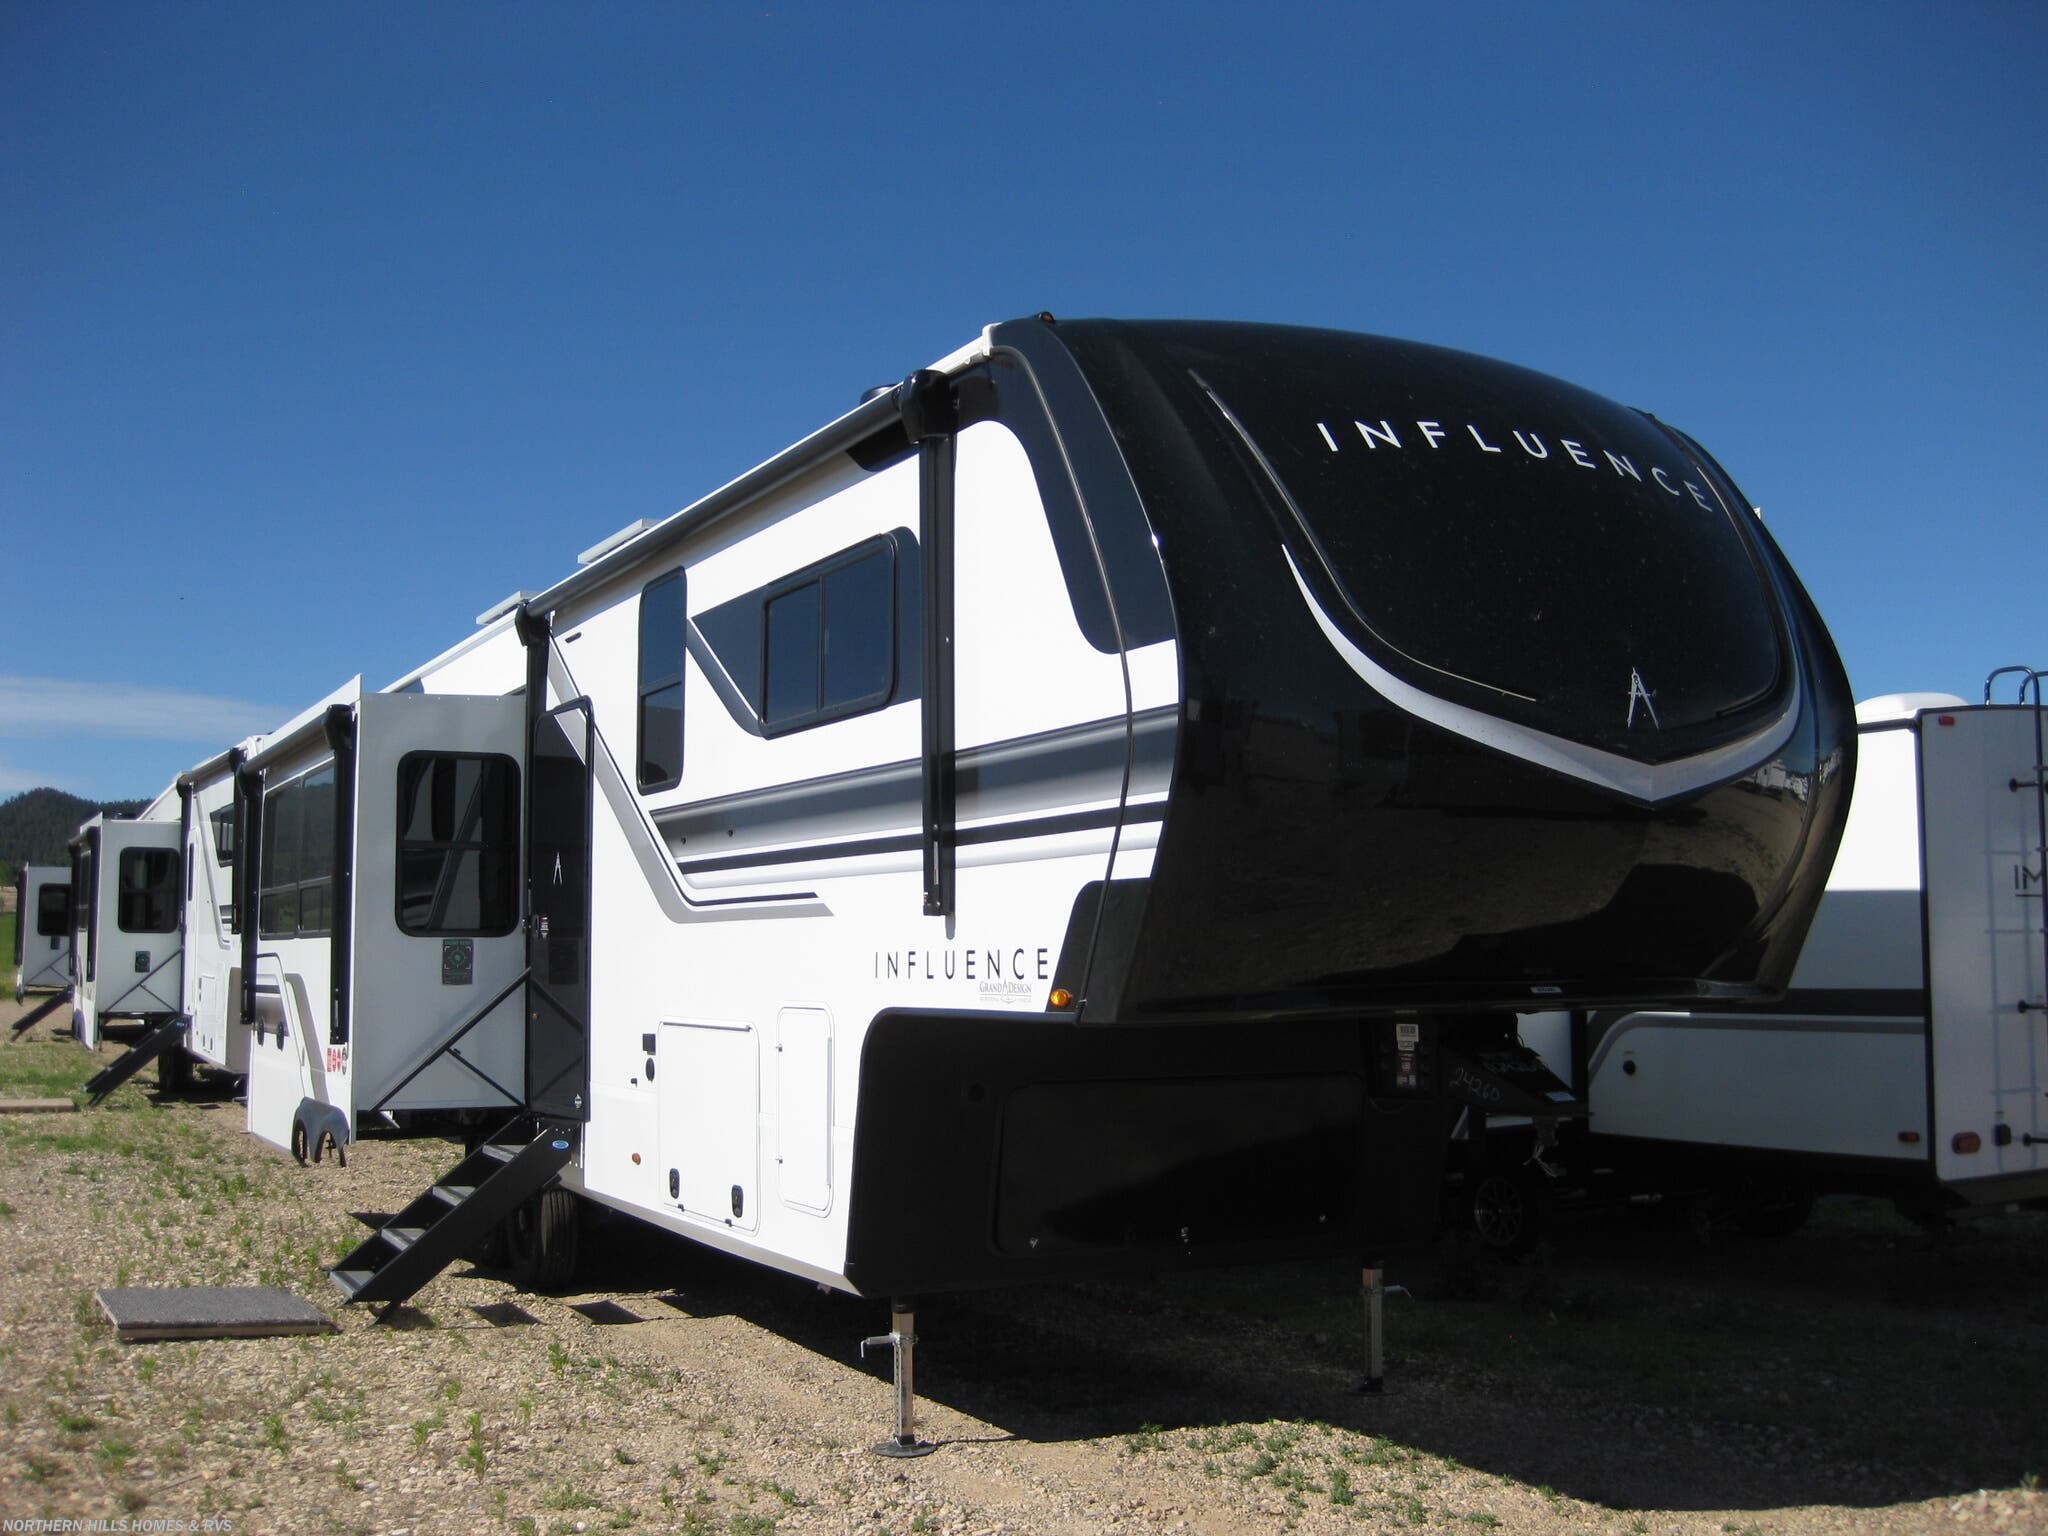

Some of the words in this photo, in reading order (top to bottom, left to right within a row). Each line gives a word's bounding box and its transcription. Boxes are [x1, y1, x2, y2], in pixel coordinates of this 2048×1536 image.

[1316, 420, 1713, 512] INFLUENCE
[874, 948, 1049, 980] INFLUENCE
[979, 981, 1002, 993] GRAND
[1008, 982, 1032, 994] DESIGN
